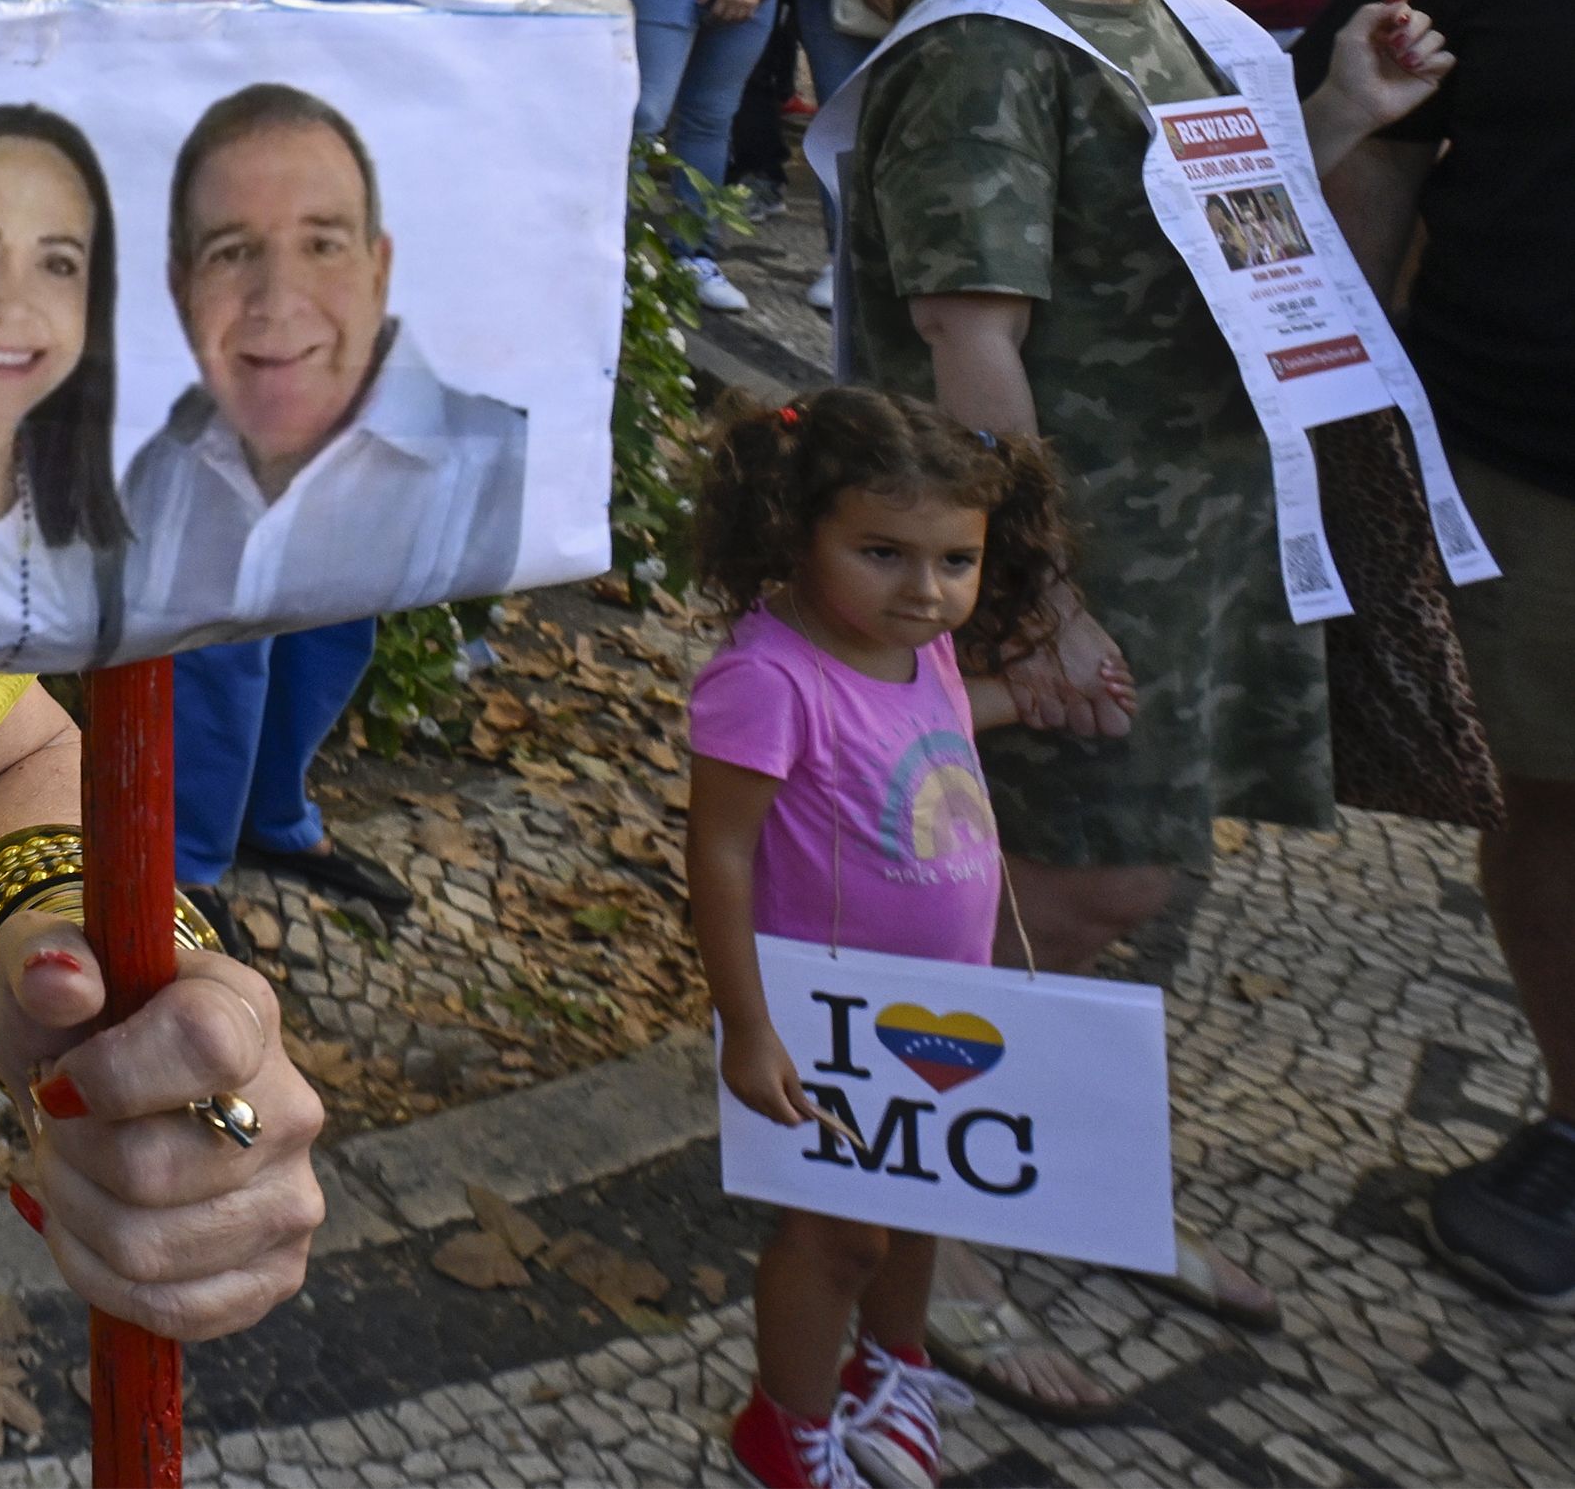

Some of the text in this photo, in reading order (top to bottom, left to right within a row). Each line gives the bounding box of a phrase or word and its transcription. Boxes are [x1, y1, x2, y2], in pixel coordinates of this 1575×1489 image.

[1173, 113, 1257, 145] REWARD
[811, 990, 871, 1080] I
[801, 1081, 1039, 1197] MC
